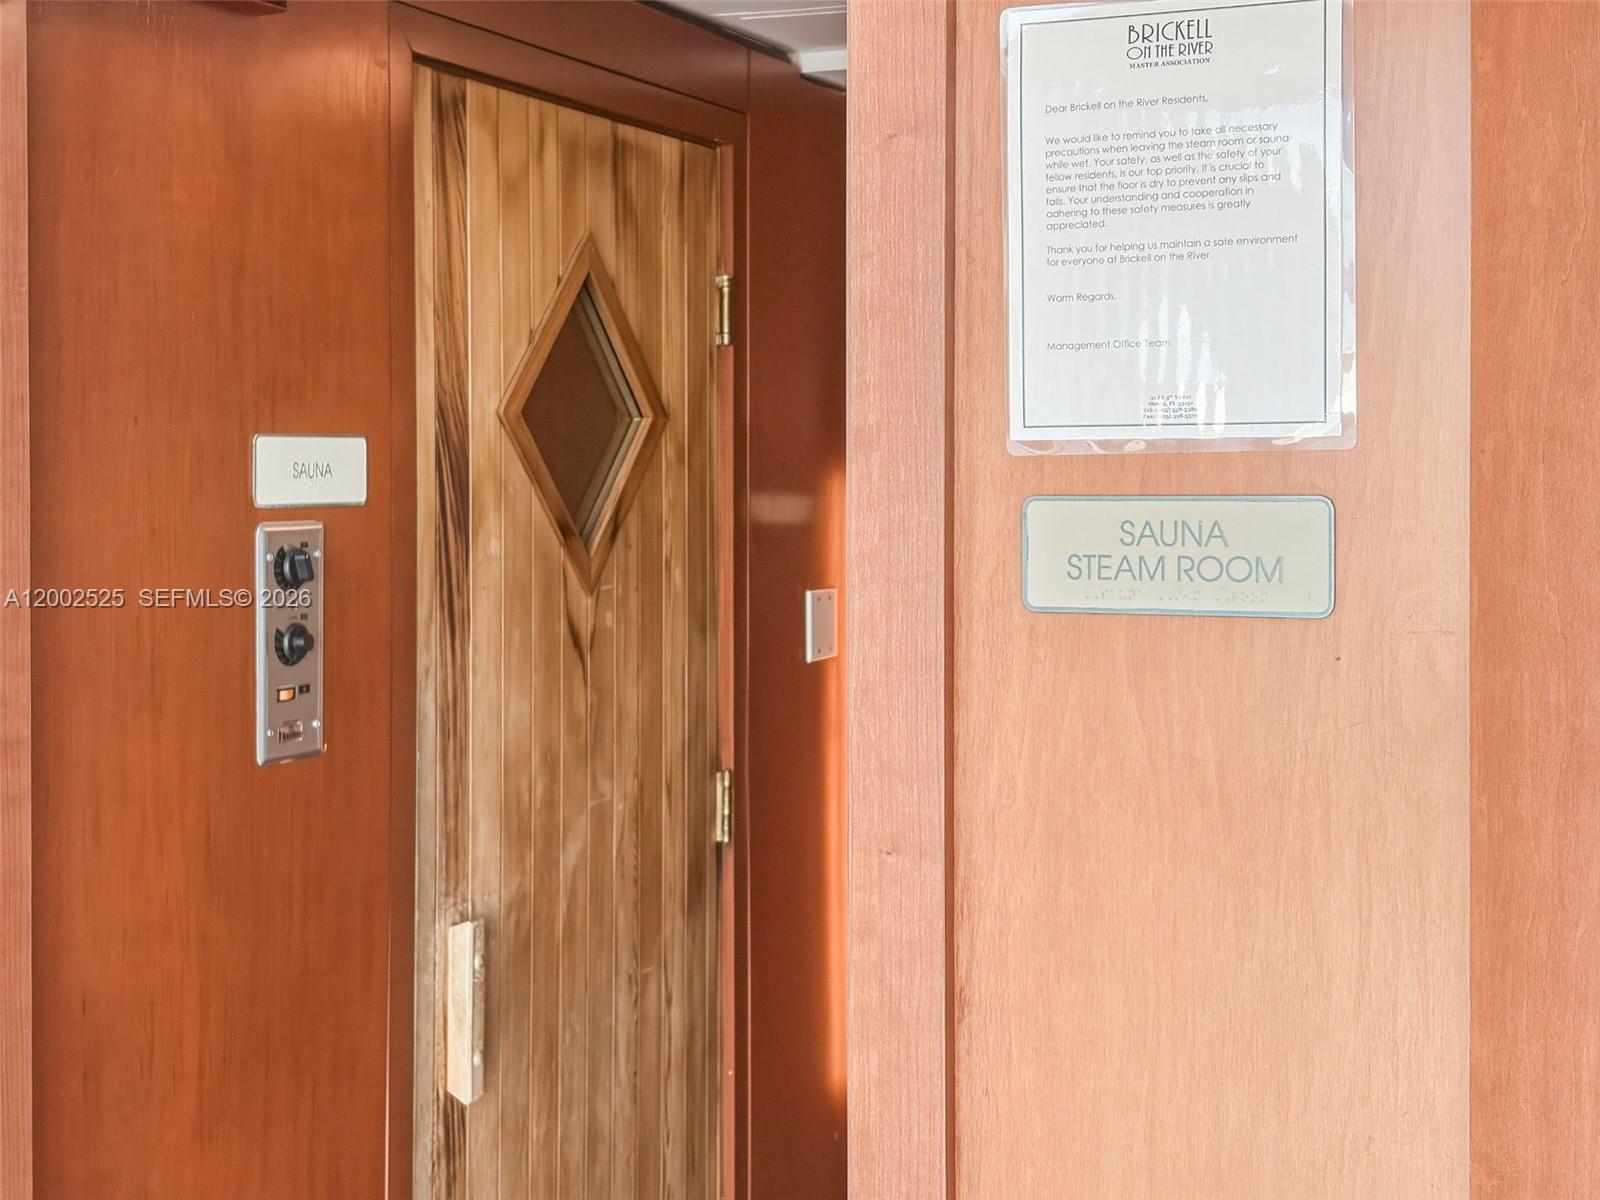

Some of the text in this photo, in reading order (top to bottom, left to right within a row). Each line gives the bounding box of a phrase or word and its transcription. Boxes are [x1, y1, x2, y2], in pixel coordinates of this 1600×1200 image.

[1128, 18, 1212, 44] BRICKELL
[1126, 41, 1213, 60] ON THE RIVER
[1160, 57, 1210, 66] ASSOCIATION
[1045, 104, 1067, 113] Dear
[1069, 101, 1101, 111] Brickell
[1103, 101, 1115, 109] on
[1118, 100, 1134, 108] the
[1136, 98, 1159, 107] River
[1045, 136, 1060, 144] We
[1062, 134, 1091, 144] would
[1092, 133, 1108, 143] like
[1110, 132, 1120, 141] to
[1122, 129, 1156, 140] remind
[1158, 130, 1176, 140] you
[1177, 128, 1188, 137] to
[1191, 126, 1212, 137] take
[1228, 123, 1277, 136] necessary
[1045, 135, 1289, 159] precautions when leaving the steam room or sauna
[1045, 160, 1069, 168] while
[1093, 158, 1115, 166] Your
[1150, 155, 1161, 163] as
[1161, 152, 1181, 163] well
[1184, 153, 1195, 161] as
[1197, 151, 1214, 160] the
[1216, 149, 1245, 159] safety
[1259, 147, 1282, 158] your
[1045, 172, 1072, 182] fellow
[1074, 169, 1117, 180] residents,
[1120, 168, 1126, 177] is
[1128, 168, 1144, 177] our
[1146, 167, 1163, 176] top
[1209, 162, 1216, 172] is
[1254, 160, 1264, 169] to
[1045, 172, 1281, 194] ensure that the floor is dry to prevent any slips and
[1067, 196, 1088, 204] Your
[1090, 192, 1158, 203] understanding
[1161, 190, 1180, 199] and
[1182, 187, 1242, 198] cooperation
[1245, 186, 1254, 194] in
[1046, 198, 1250, 218] adhering to these safety measures is greatly
[1046, 234, 1297, 255] Thank you for helping us maintain a safe environment
[1046, 257, 1059, 266] for
[1061, 254, 1104, 266] everyone
[1107, 254, 1117, 264] at
[1119, 253, 1151, 263] Brickell
[1169, 251, 1184, 260] the
[1046, 294, 1073, 302] Warm
[1047, 340, 1110, 351] Management
[1112, 338, 1141, 348] Office
[292, 461, 333, 479] SAUNA
[1119, 520, 1229, 547] SAUNA
[1067, 554, 1284, 583] STEAM ROOM
